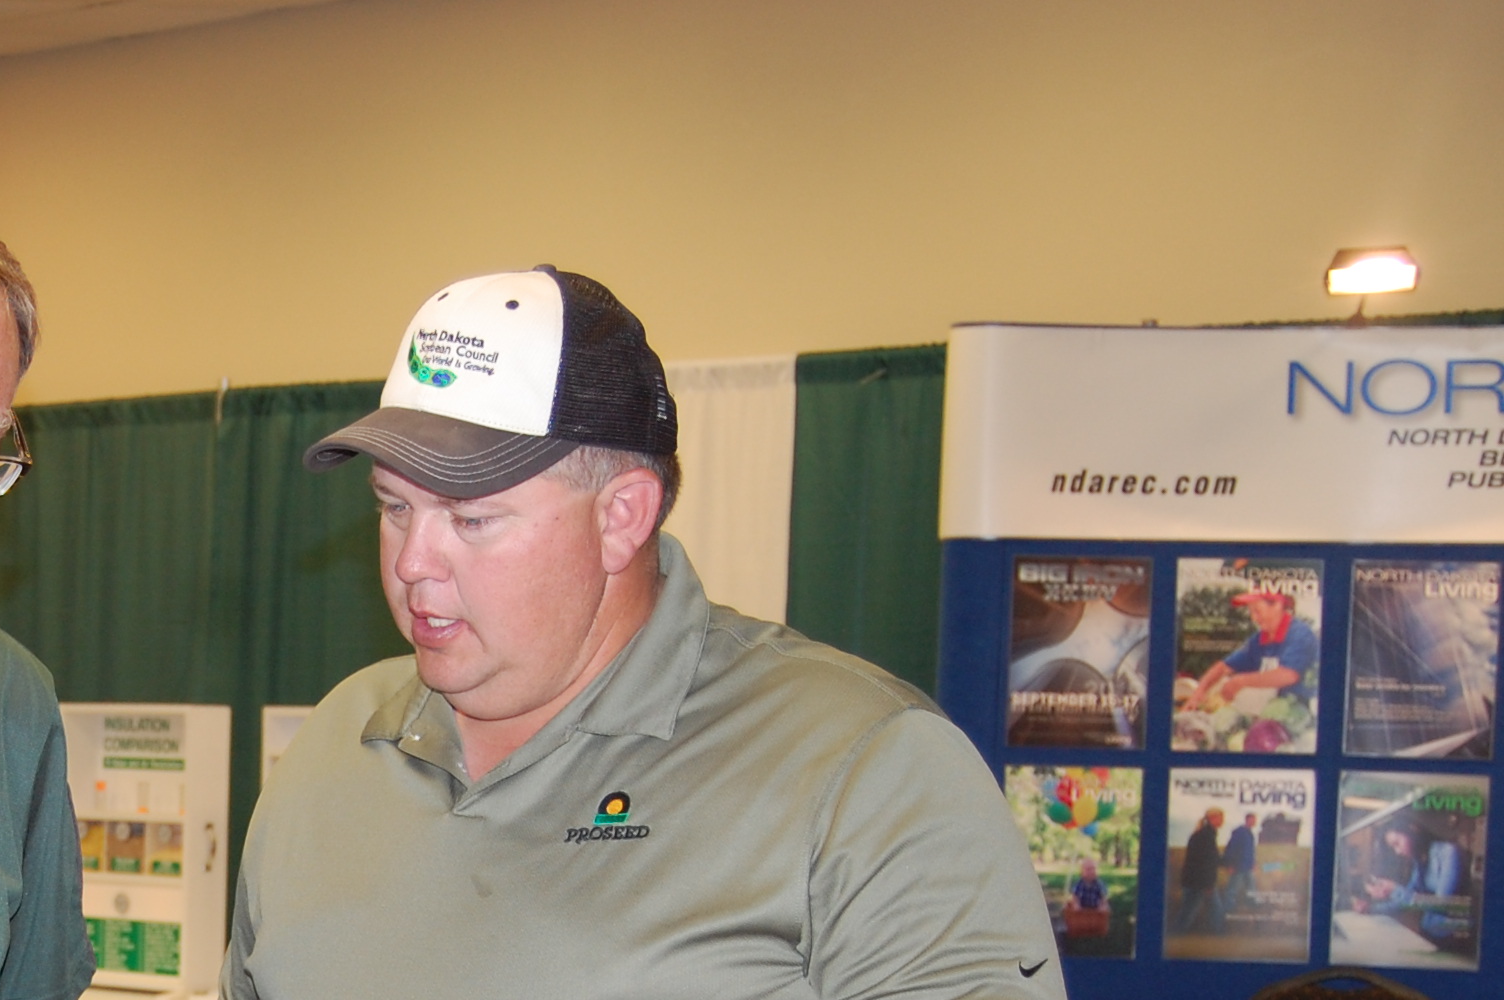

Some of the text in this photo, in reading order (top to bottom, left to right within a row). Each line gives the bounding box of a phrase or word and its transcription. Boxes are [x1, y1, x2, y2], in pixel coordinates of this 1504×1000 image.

[416, 328, 484, 348] North Dakota
[420, 342, 499, 363] Soybean Council
[1287, 359, 1504, 416] NOR
[1388, 428, 1489, 446] NORTH
[1051, 468, 1237, 495] ndarec.com
[1019, 564, 1068, 582] BIG
[1249, 568, 1318, 580] DAKOTA
[1355, 569, 1424, 583] NORTH
[1248, 580, 1319, 596] Living
[1425, 582, 1498, 603] Living
[1010, 692, 1096, 712] SEPTEMBER
[1175, 778, 1305, 791] NORTH DAKOTA
[1239, 790, 1306, 810] Living
[1413, 793, 1483, 817] Living
[564, 825, 650, 844] PROSEED
